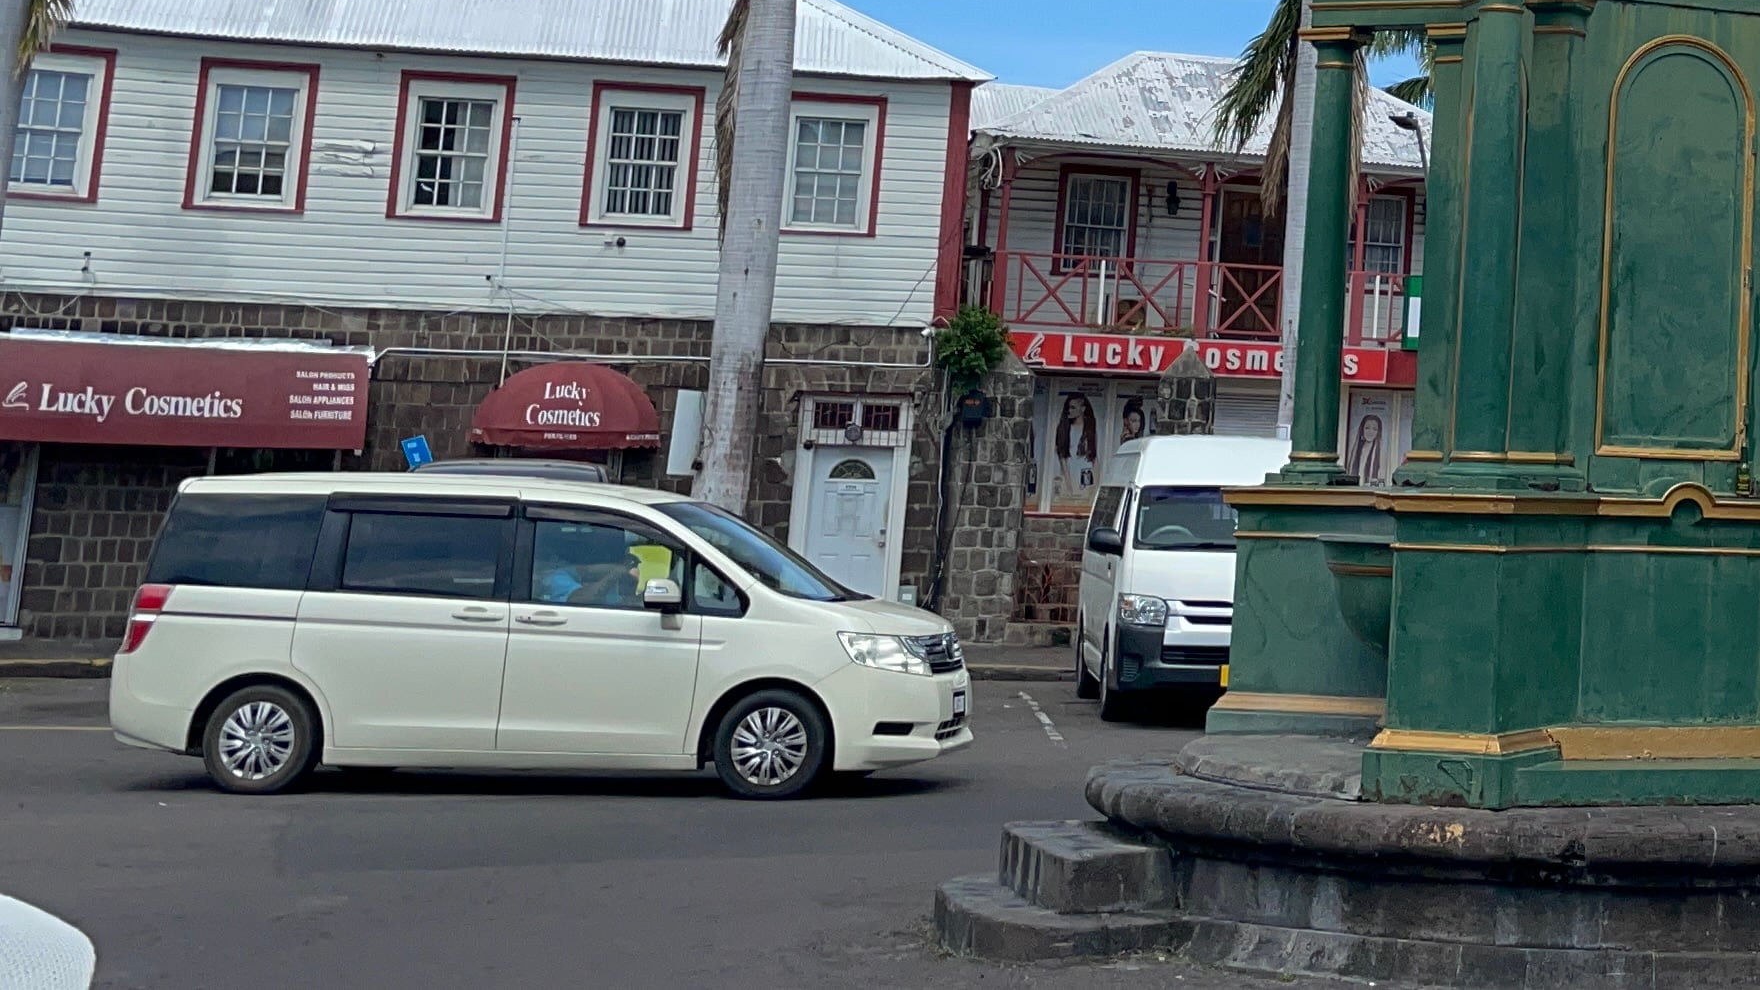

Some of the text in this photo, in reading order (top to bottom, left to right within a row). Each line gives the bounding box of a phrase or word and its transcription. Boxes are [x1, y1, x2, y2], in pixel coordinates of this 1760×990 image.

[1063, 335, 1164, 371] Lucky
[296, 370, 318, 379] SALON
[313, 383, 330, 391] HAIR
[544, 381, 590, 406] Lucky
[38, 383, 243, 422] Lucky Cosmetics
[289, 394, 354, 405] SALON APPLIANCES
[290, 410, 312, 419] SALON
[526, 404, 600, 427] Cosmetics
